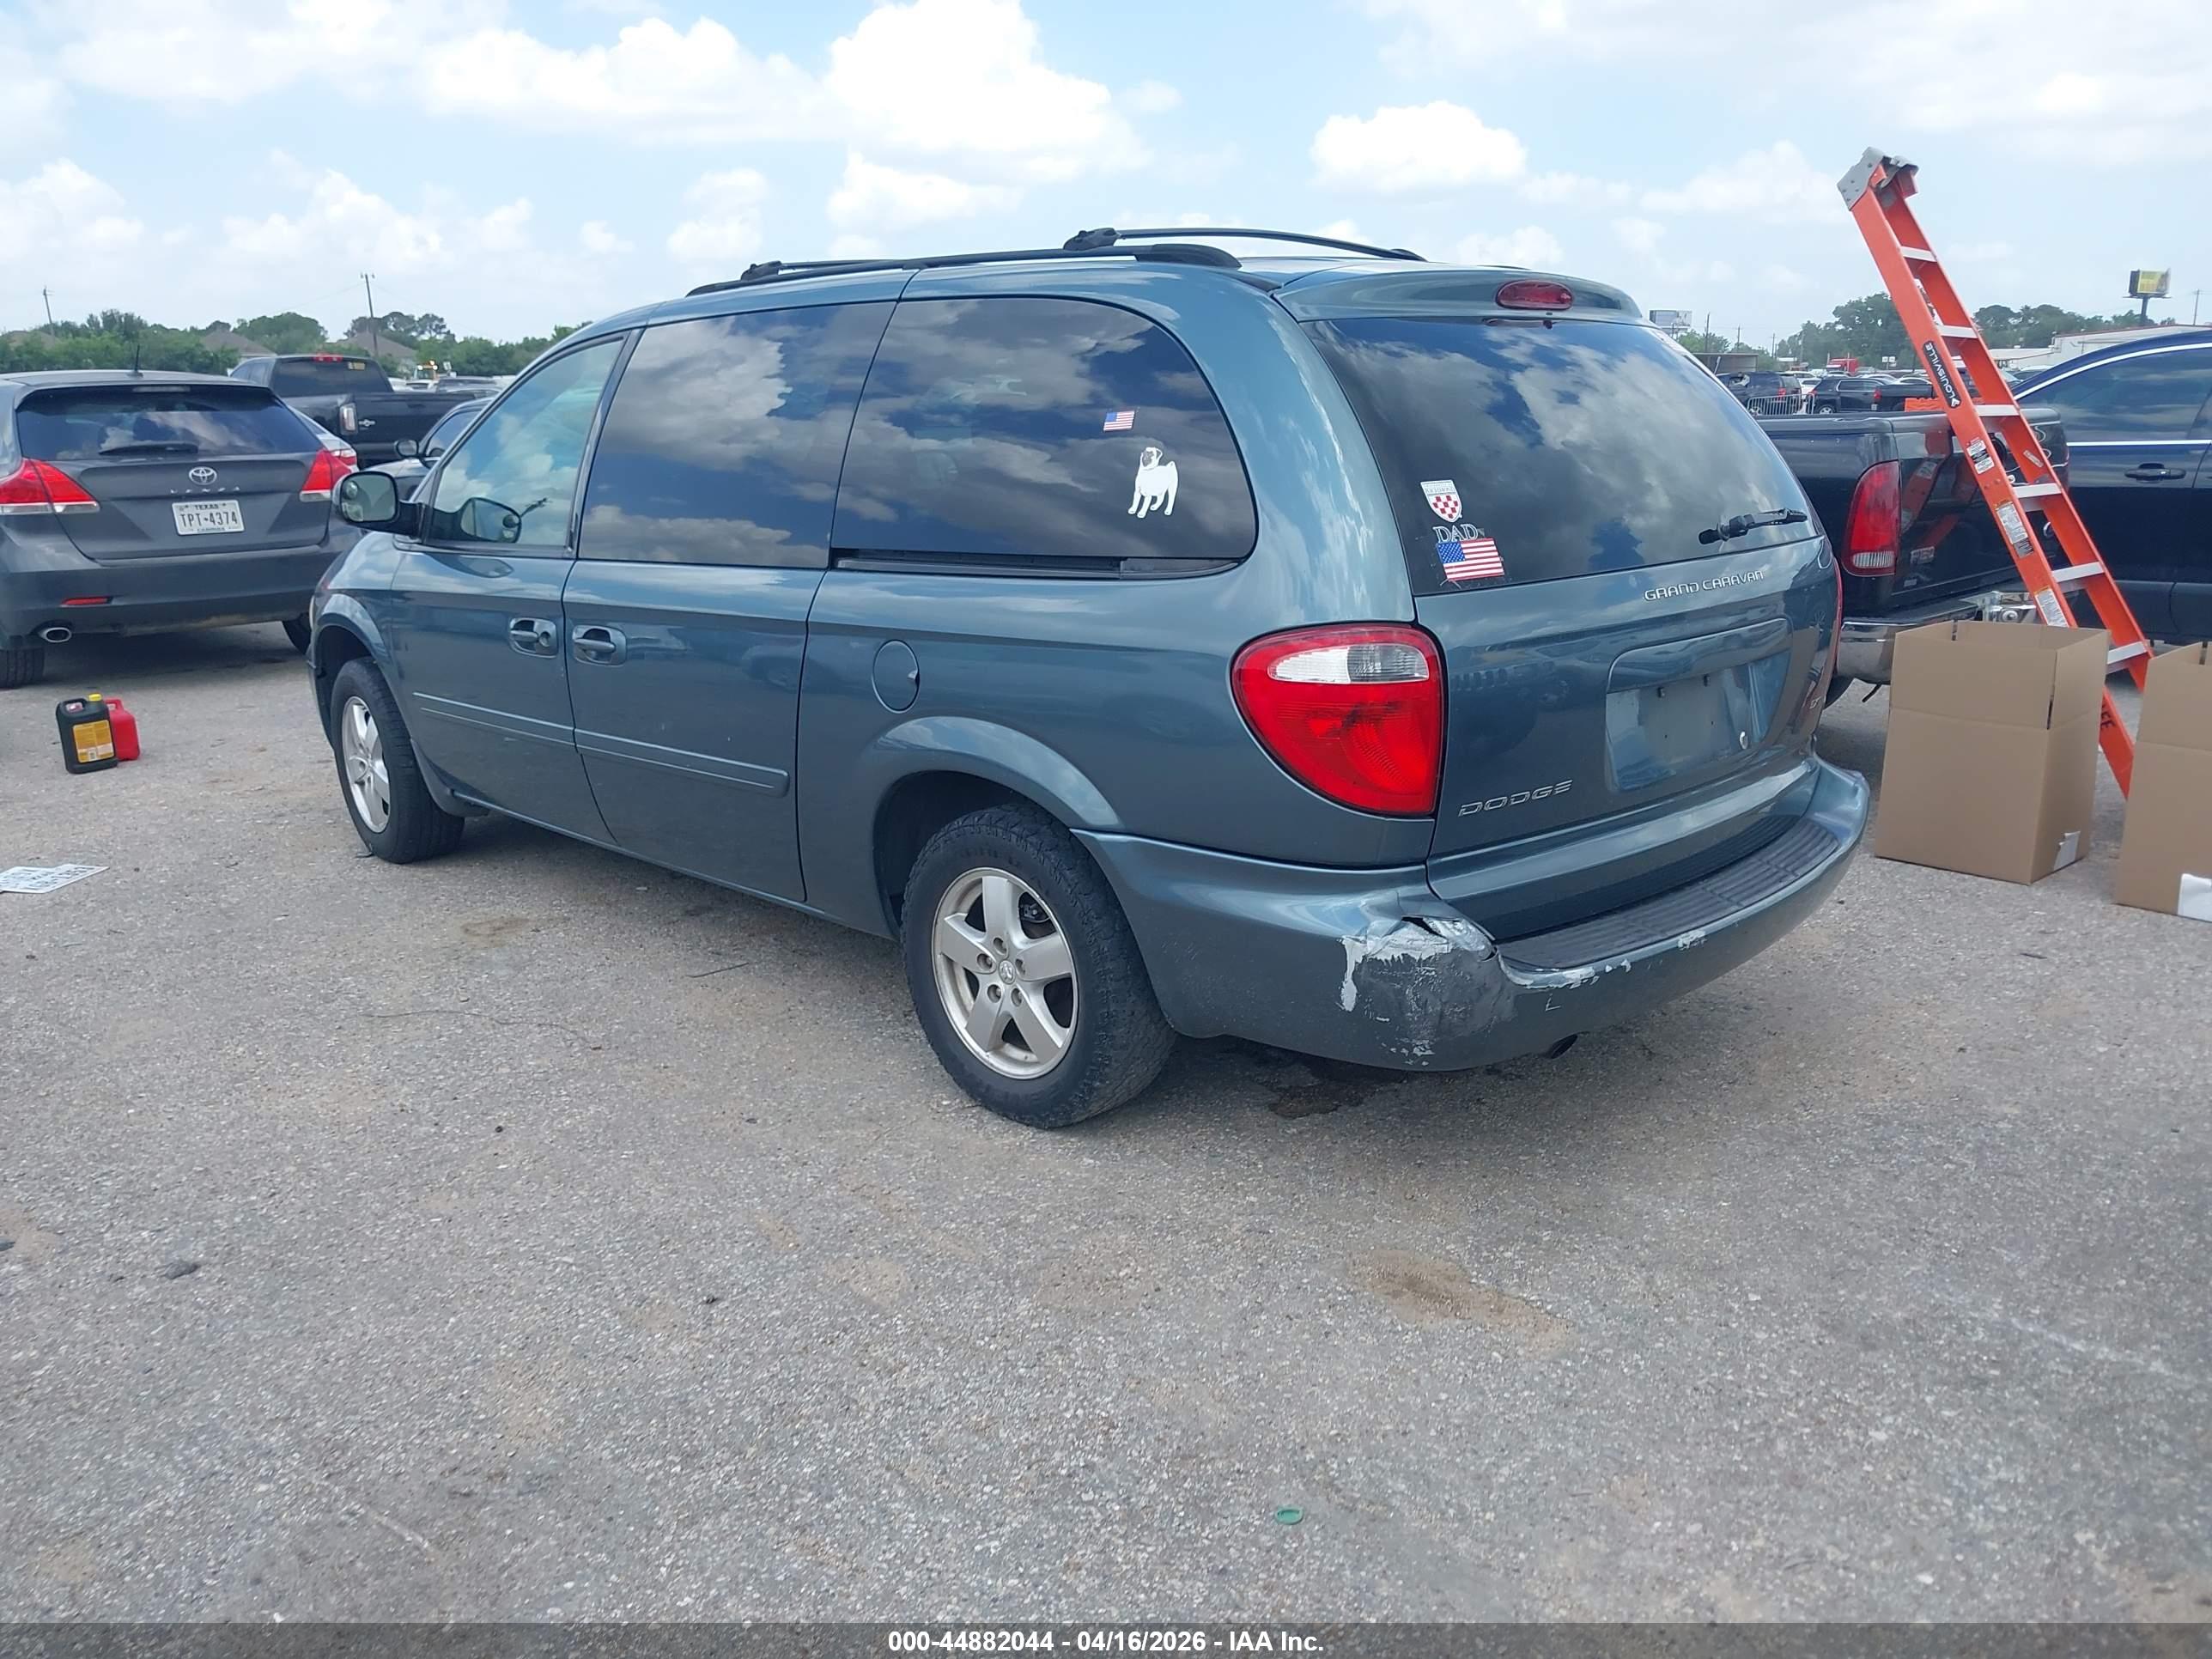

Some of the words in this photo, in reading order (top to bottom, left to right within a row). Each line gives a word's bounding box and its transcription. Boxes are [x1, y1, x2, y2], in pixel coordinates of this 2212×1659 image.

[1925, 343, 1956, 399] LOUISVILLE
[1432, 523, 1479, 544] DAD
[1644, 582, 1699, 601] GRAND
[1702, 570, 1764, 591] CARAVAN
[1458, 780, 1573, 817] DODGE
